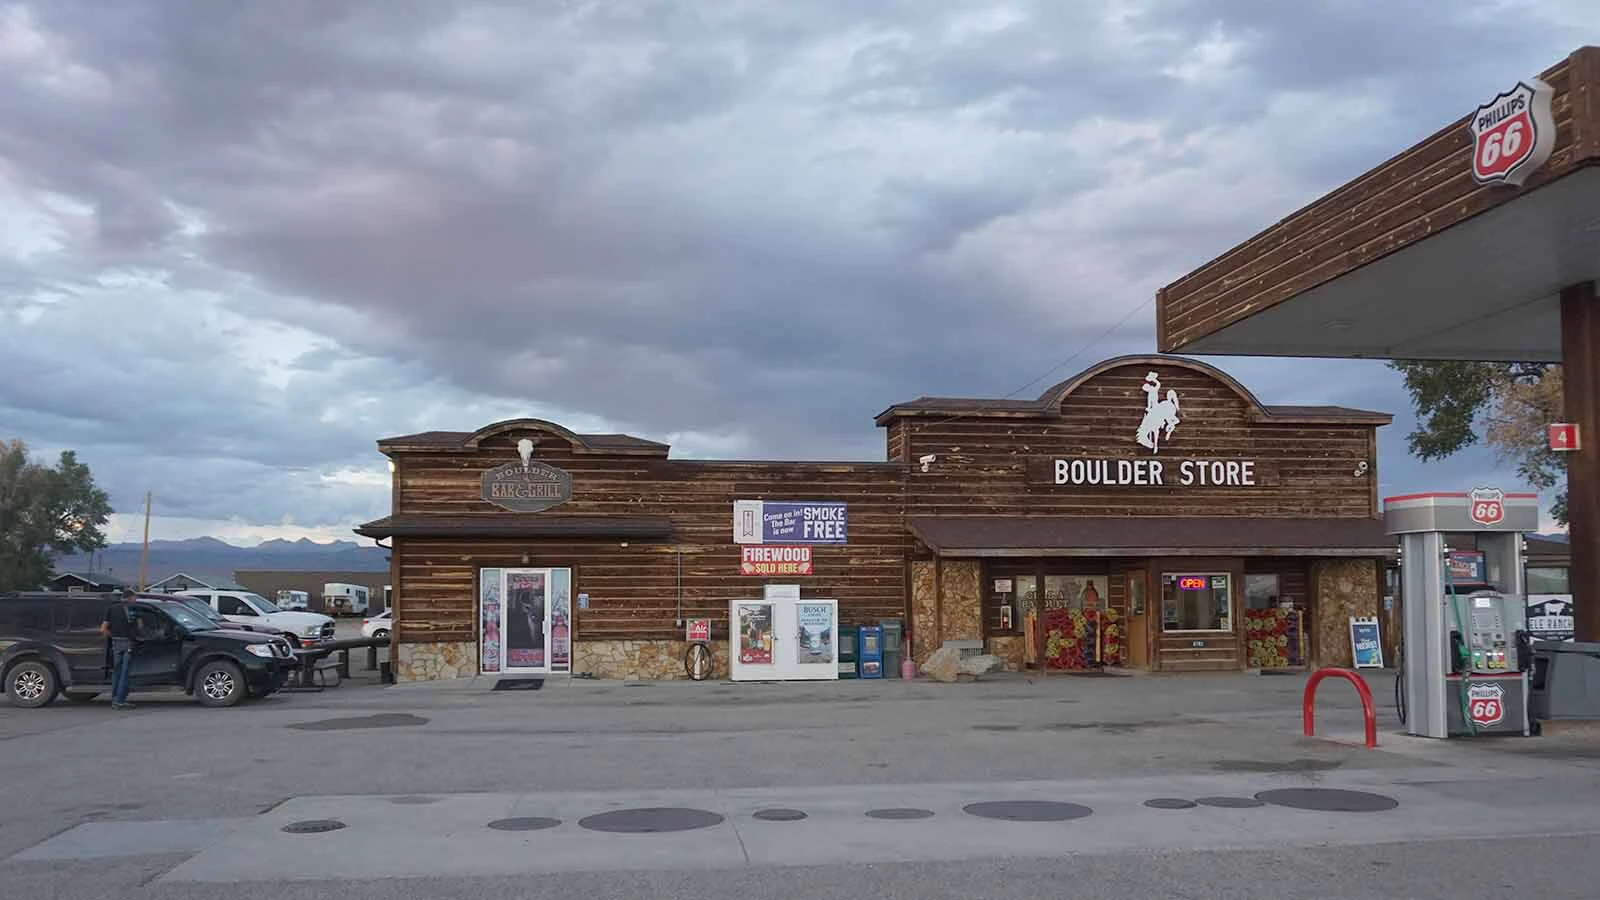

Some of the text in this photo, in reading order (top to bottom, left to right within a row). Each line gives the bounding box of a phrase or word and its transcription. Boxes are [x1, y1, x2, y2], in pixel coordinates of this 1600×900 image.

[1478, 93, 1525, 132] PHILLIPS
[1481, 121, 1523, 167] 66
[1557, 431, 1567, 443] 4
[495, 466, 558, 481] BOULDER
[1054, 459, 1256, 486] BOULDER STORE
[491, 482, 515, 497] BAR
[528, 482, 561, 498] GRILL
[763, 513, 782, 521] Come
[793, 509, 803, 517] in!
[803, 507, 845, 520] SMOKE
[1475, 503, 1498, 518] 66
[771, 520, 783, 528] The
[773, 527, 794, 535] is now
[803, 520, 845, 538] FREE
[743, 547, 810, 562] FIREWOOD
[755, 562, 798, 573] SOLD HERE
[1181, 578, 1205, 588] OPEN
[803, 606, 826, 614] BUSCH
[1547, 618, 1573, 629] RANCH
[1473, 701, 1497, 717] 66
